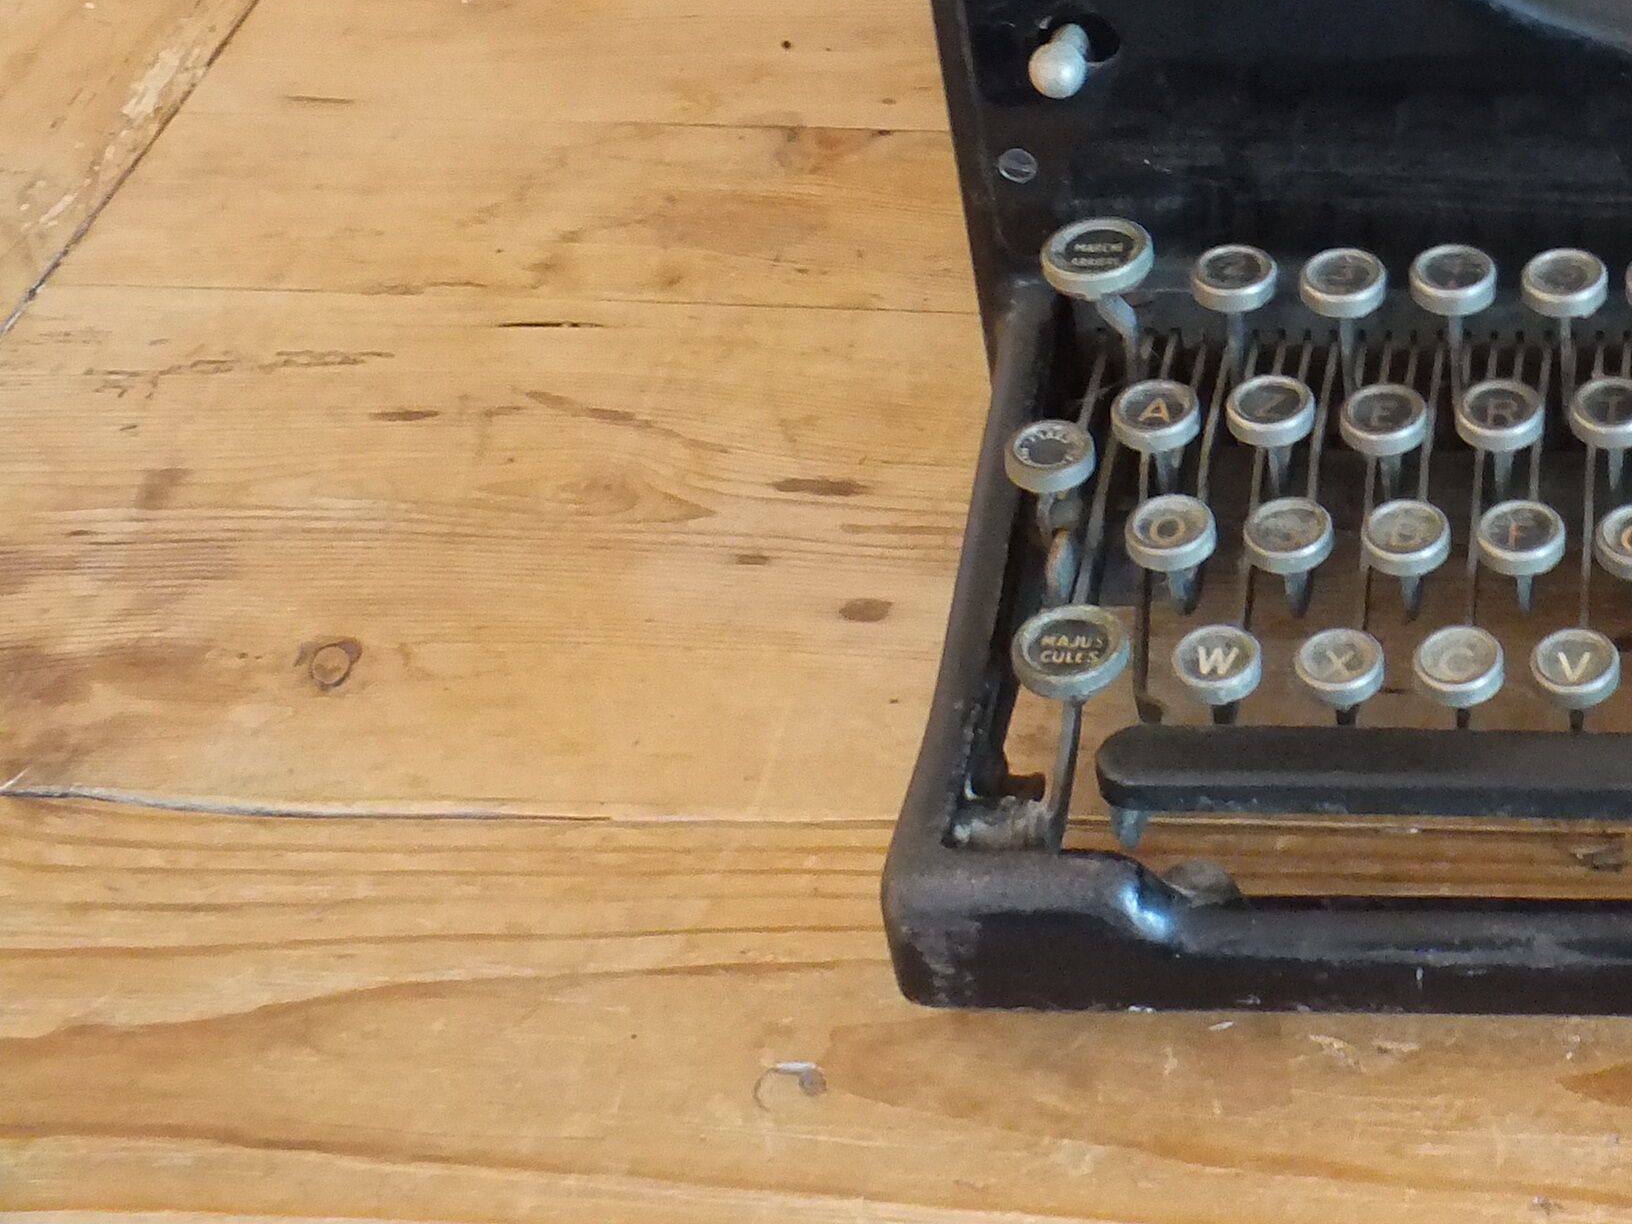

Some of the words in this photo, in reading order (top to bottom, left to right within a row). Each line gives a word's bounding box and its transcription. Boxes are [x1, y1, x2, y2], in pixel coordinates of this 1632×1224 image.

[1137, 397, 1172, 424] A
[1254, 392, 1287, 417] Z
[1486, 397, 1519, 425] R
[1600, 395, 1625, 422] T
[1039, 634, 1104, 649] MAJUS
[1038, 649, 1101, 665] CULES
[1196, 644, 1240, 675] W
[1325, 650, 1354, 673] X
[1438, 646, 1474, 676] C
[1556, 650, 1591, 683] V
